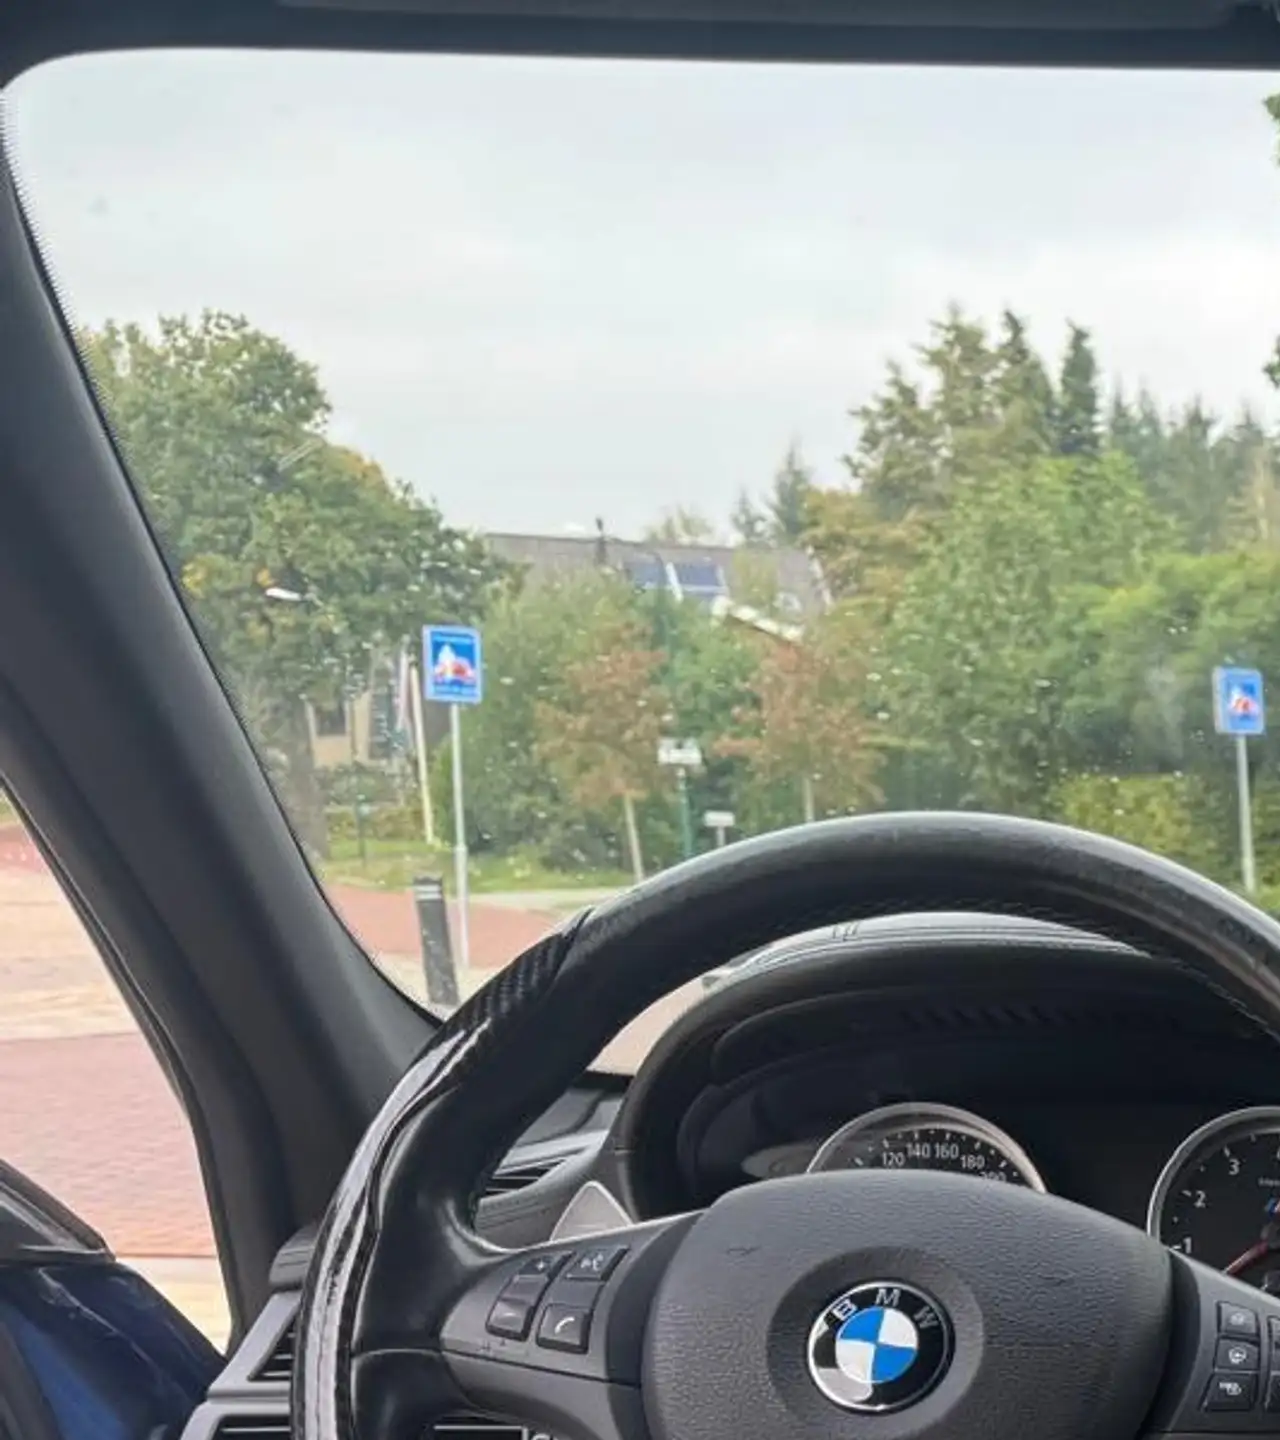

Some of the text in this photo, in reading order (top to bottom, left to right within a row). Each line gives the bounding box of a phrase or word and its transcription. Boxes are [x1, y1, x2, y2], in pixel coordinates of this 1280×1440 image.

[882, 1152, 905, 1166] 120
[906, 1143, 930, 1158] 140
[934, 1143, 959, 1158] 160
[960, 1154, 985, 1169] 180
[1229, 1159, 1240, 1175] 3
[1194, 1190, 1206, 1208] 2
[1183, 1238, 1192, 1253] 1
[832, 1288, 939, 1328] BMW
